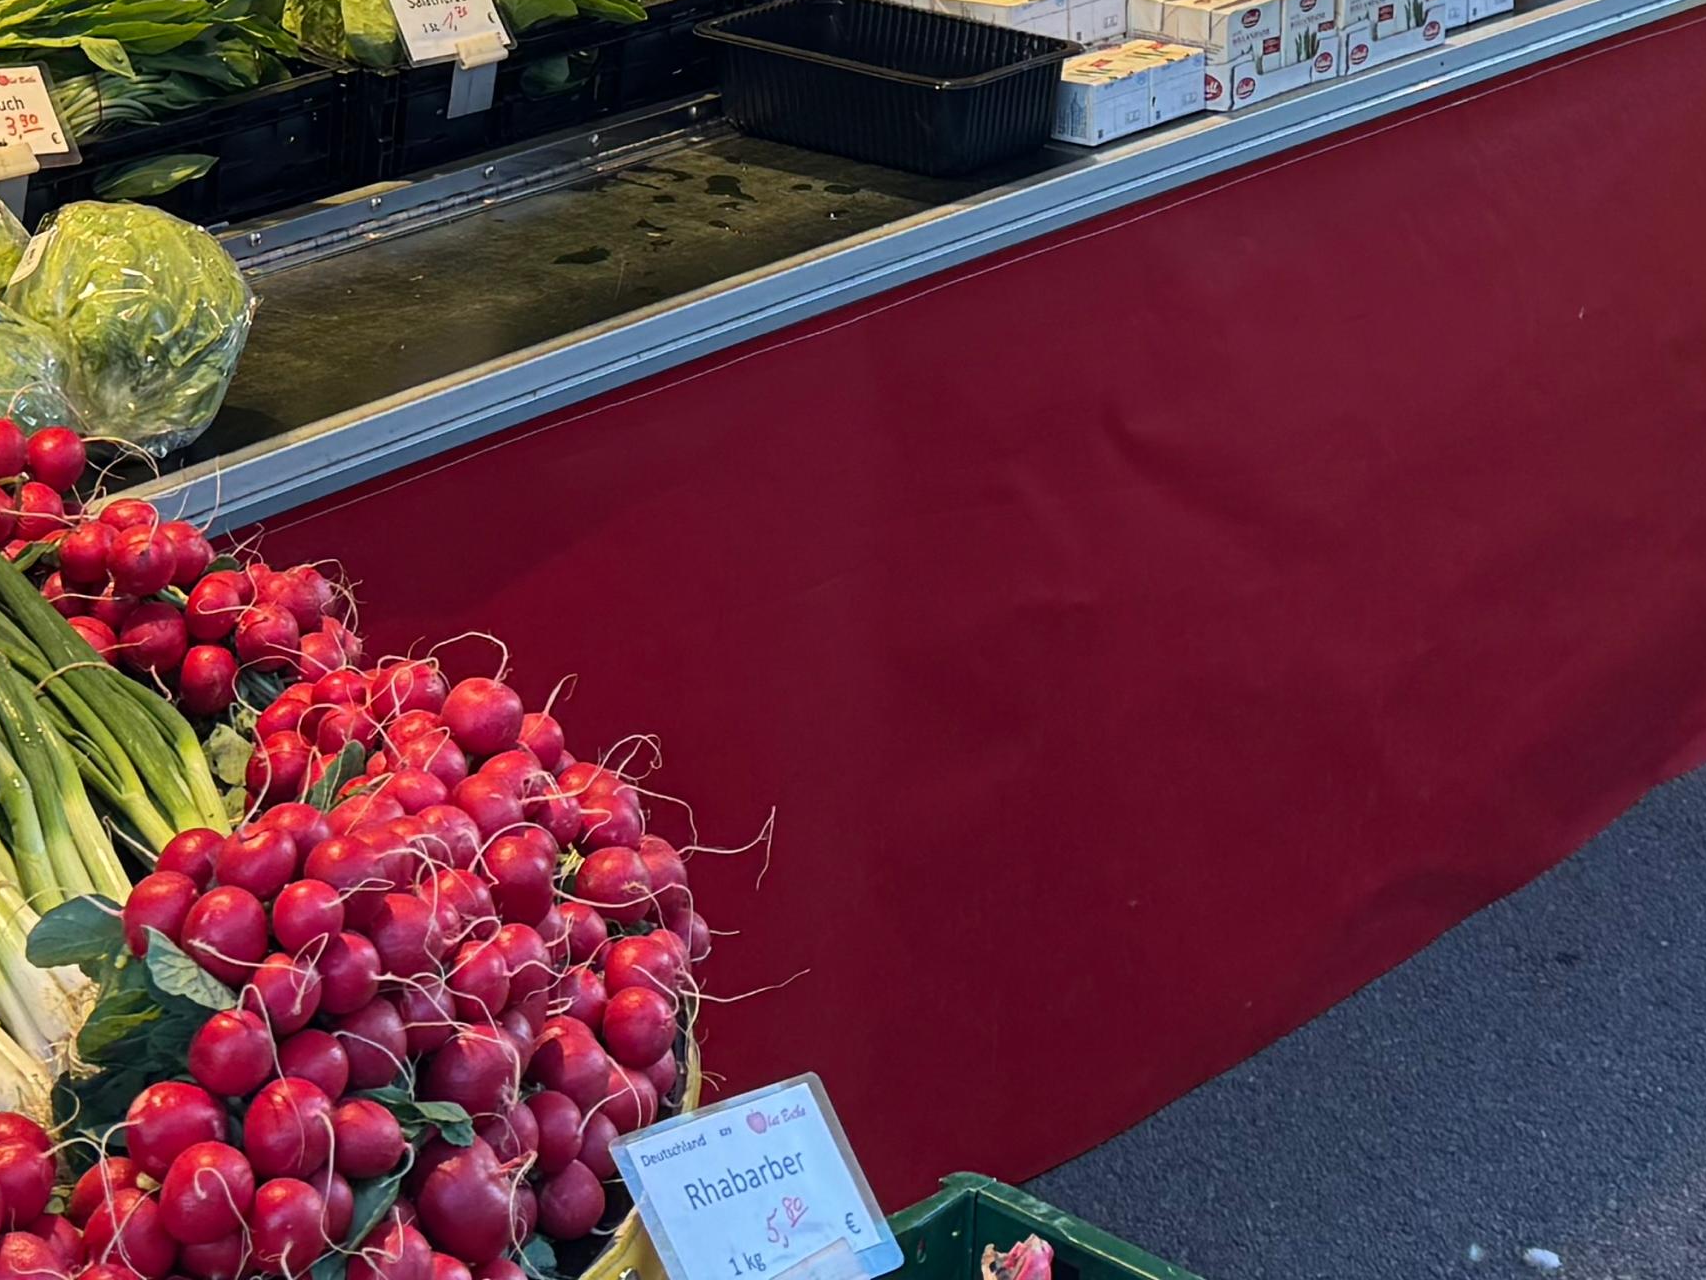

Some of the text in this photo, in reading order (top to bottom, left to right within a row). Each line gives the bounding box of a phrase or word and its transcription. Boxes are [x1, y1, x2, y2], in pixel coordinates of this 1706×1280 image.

[683, 1148, 806, 1211] Rhabarber
[844, 1211, 861, 1235] €
[728, 1251, 767, 1276] 1 kg
